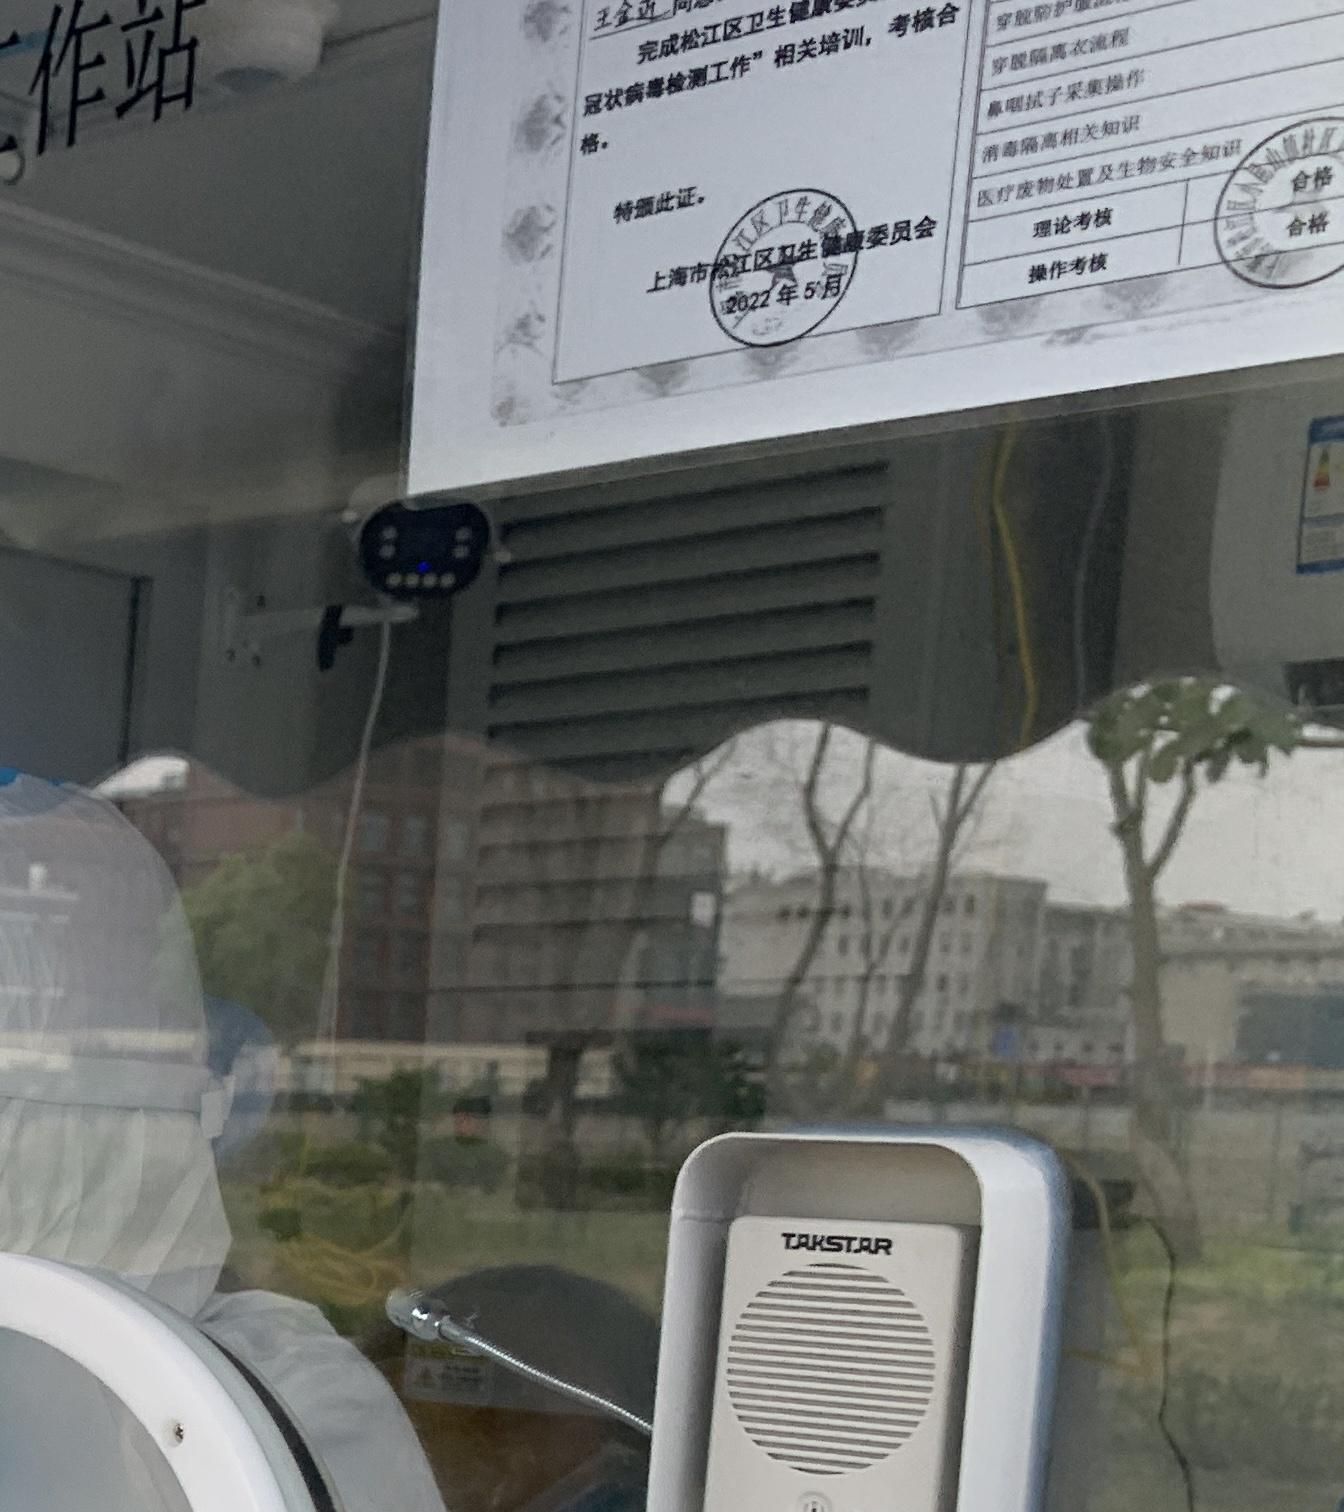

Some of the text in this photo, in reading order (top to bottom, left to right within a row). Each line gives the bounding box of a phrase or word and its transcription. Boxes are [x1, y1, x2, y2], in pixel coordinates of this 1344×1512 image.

[1031, 207, 1113, 239] 理论考核
[1027, 252, 1109, 285] 操作考核
[781, 1231, 894, 1255] TAKSTAR
